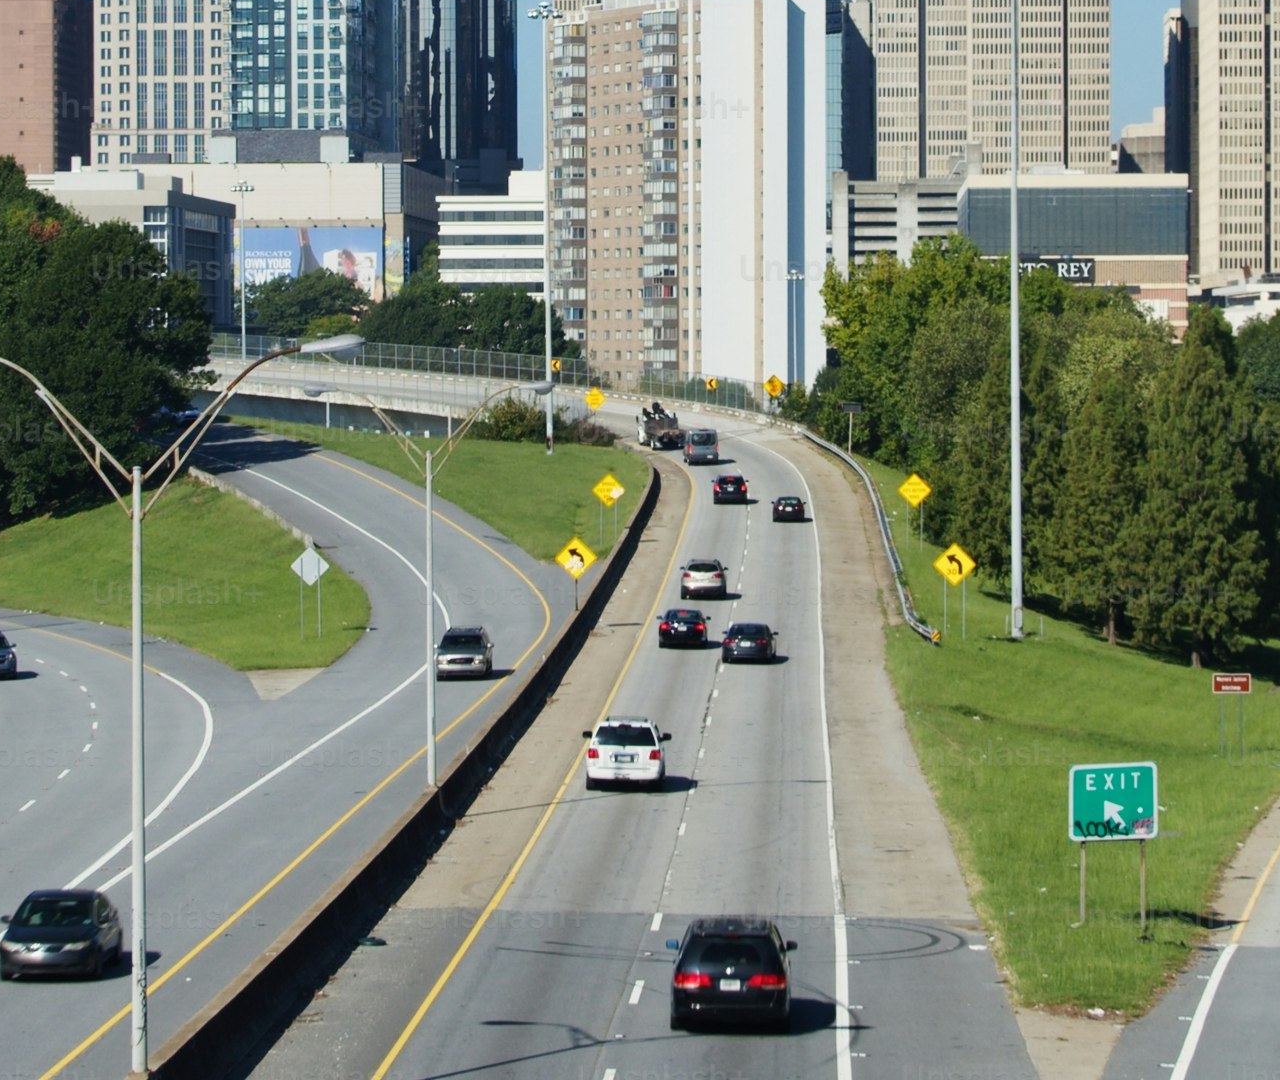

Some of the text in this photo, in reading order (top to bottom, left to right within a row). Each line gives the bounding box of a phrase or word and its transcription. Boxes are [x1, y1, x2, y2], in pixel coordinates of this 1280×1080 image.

[245, 258, 292, 269] OWN YOUR
[1057, 262, 1092, 277] REY
[1086, 772, 1141, 791] EXIT
